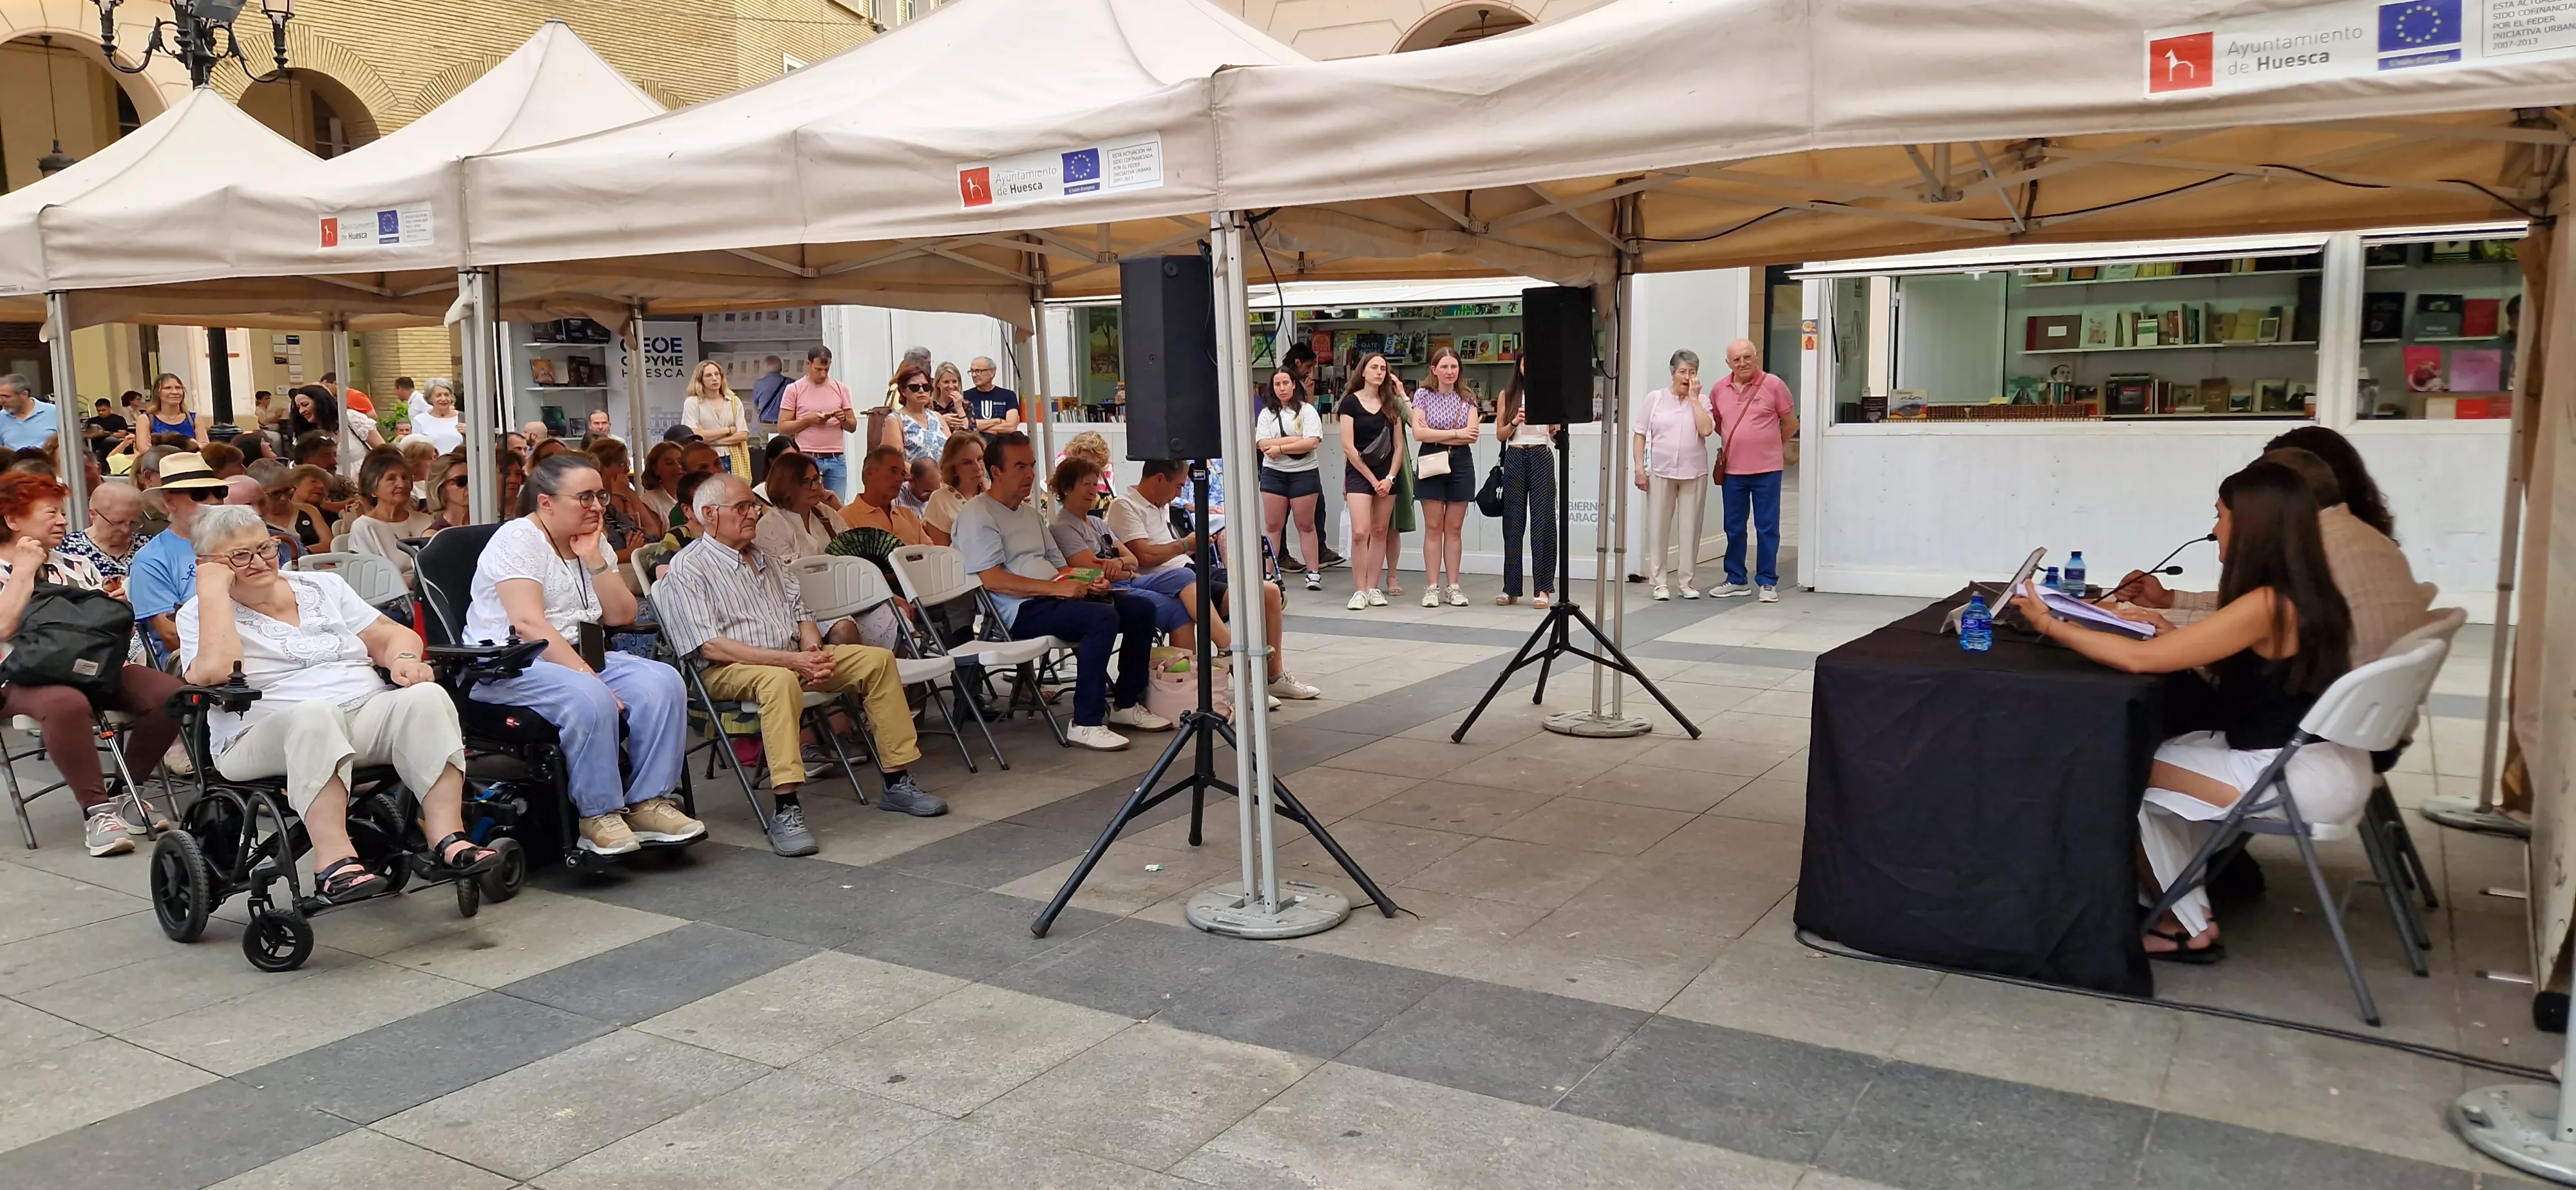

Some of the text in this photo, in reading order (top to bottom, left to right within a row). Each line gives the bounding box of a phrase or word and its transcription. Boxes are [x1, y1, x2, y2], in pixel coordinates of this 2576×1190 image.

[2493, 2, 2514, 10] ESTA
[2493, 11, 2515, 20] SIDO
[2493, 21, 2510, 30] POR
[2527, 15, 2555, 25] FEDER
[2493, 28, 2541, 39] INICIATIVA
[2227, 26, 2363, 58] Ayuntamiento
[2492, 38, 2538, 50] 2007-2013
[2228, 52, 2329, 76] de Huesca
[996, 167, 1057, 186] Ayuntamiento
[997, 182, 1043, 196] de Huesca
[621, 355, 684, 366] CPYME
[622, 368, 685, 378] HESCA
[1569, 513, 1615, 522] ARAGN
